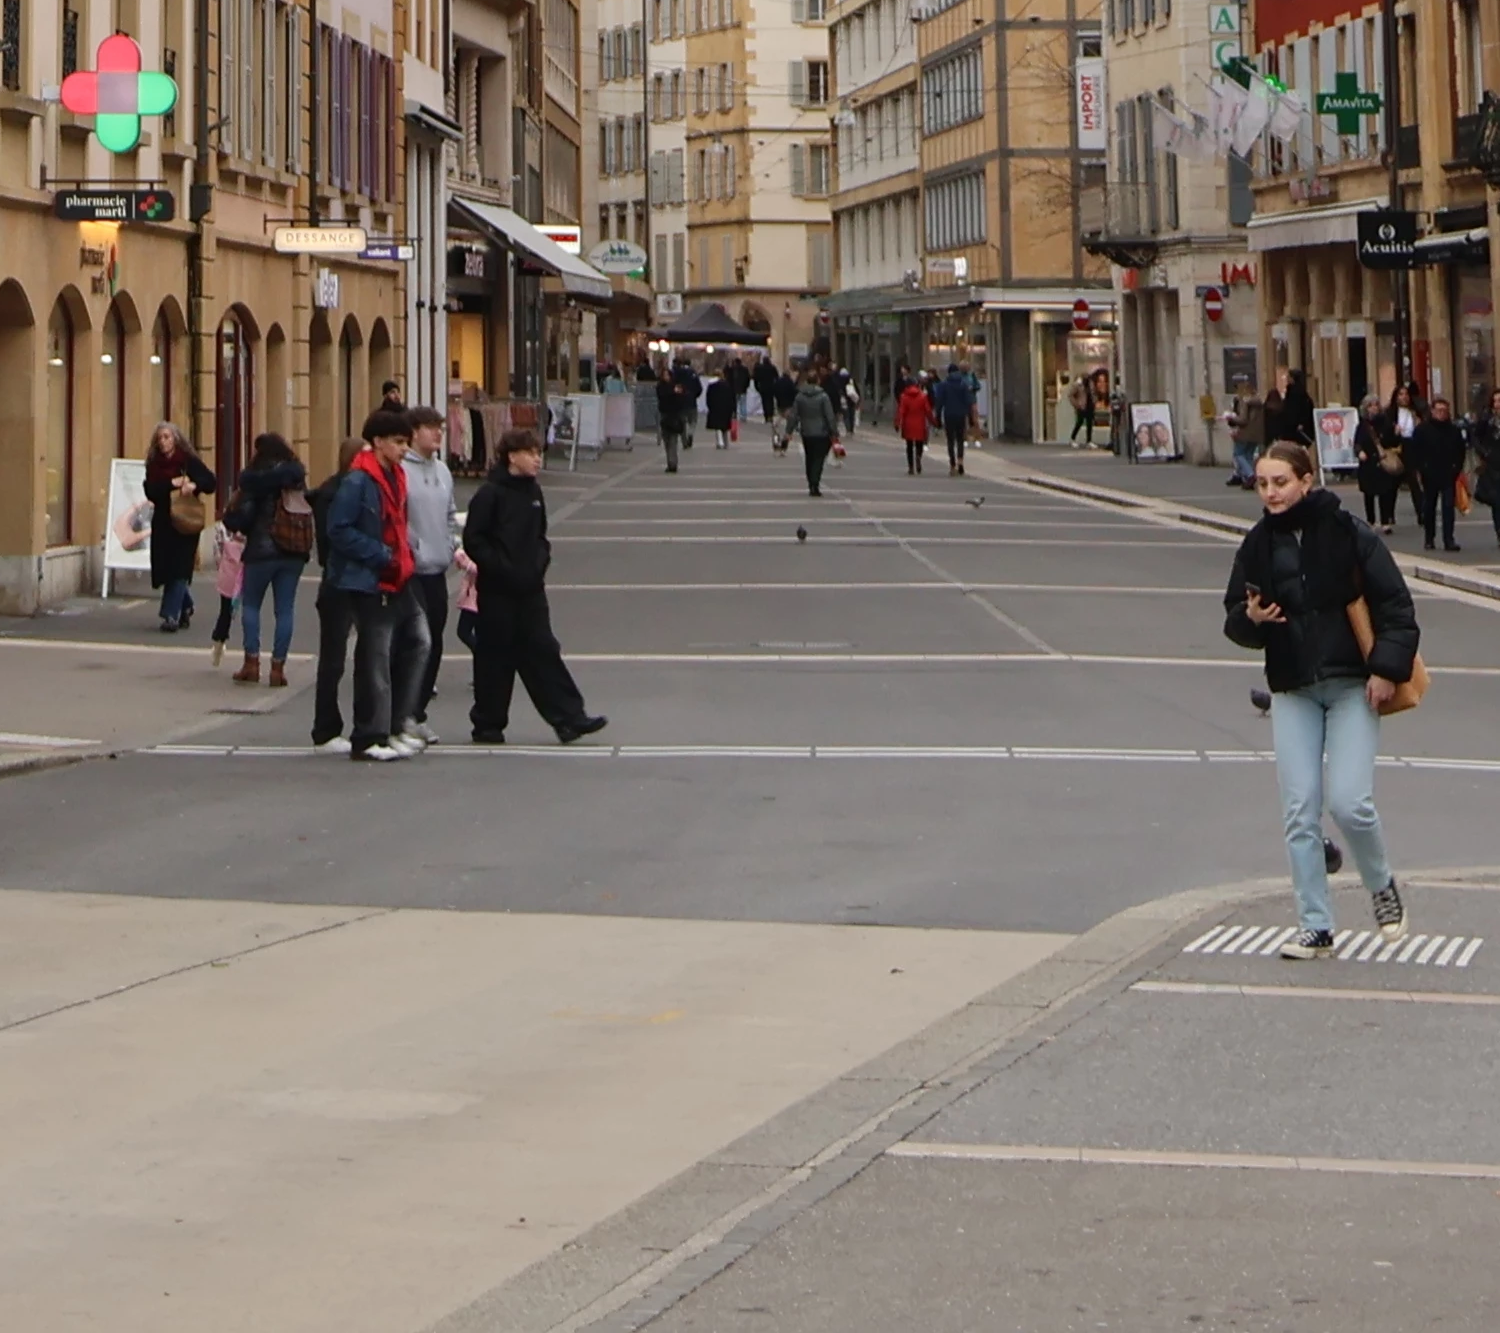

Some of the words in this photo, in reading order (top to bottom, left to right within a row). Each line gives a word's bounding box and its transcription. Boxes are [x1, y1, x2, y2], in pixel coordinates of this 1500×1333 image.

[1081, 75, 1093, 130] IMPORT
[66, 195, 126, 208] pharmacie
[95, 206, 126, 217] marti
[286, 233, 355, 244] DESSANGE
[1362, 240, 1415, 253] Acuitis
